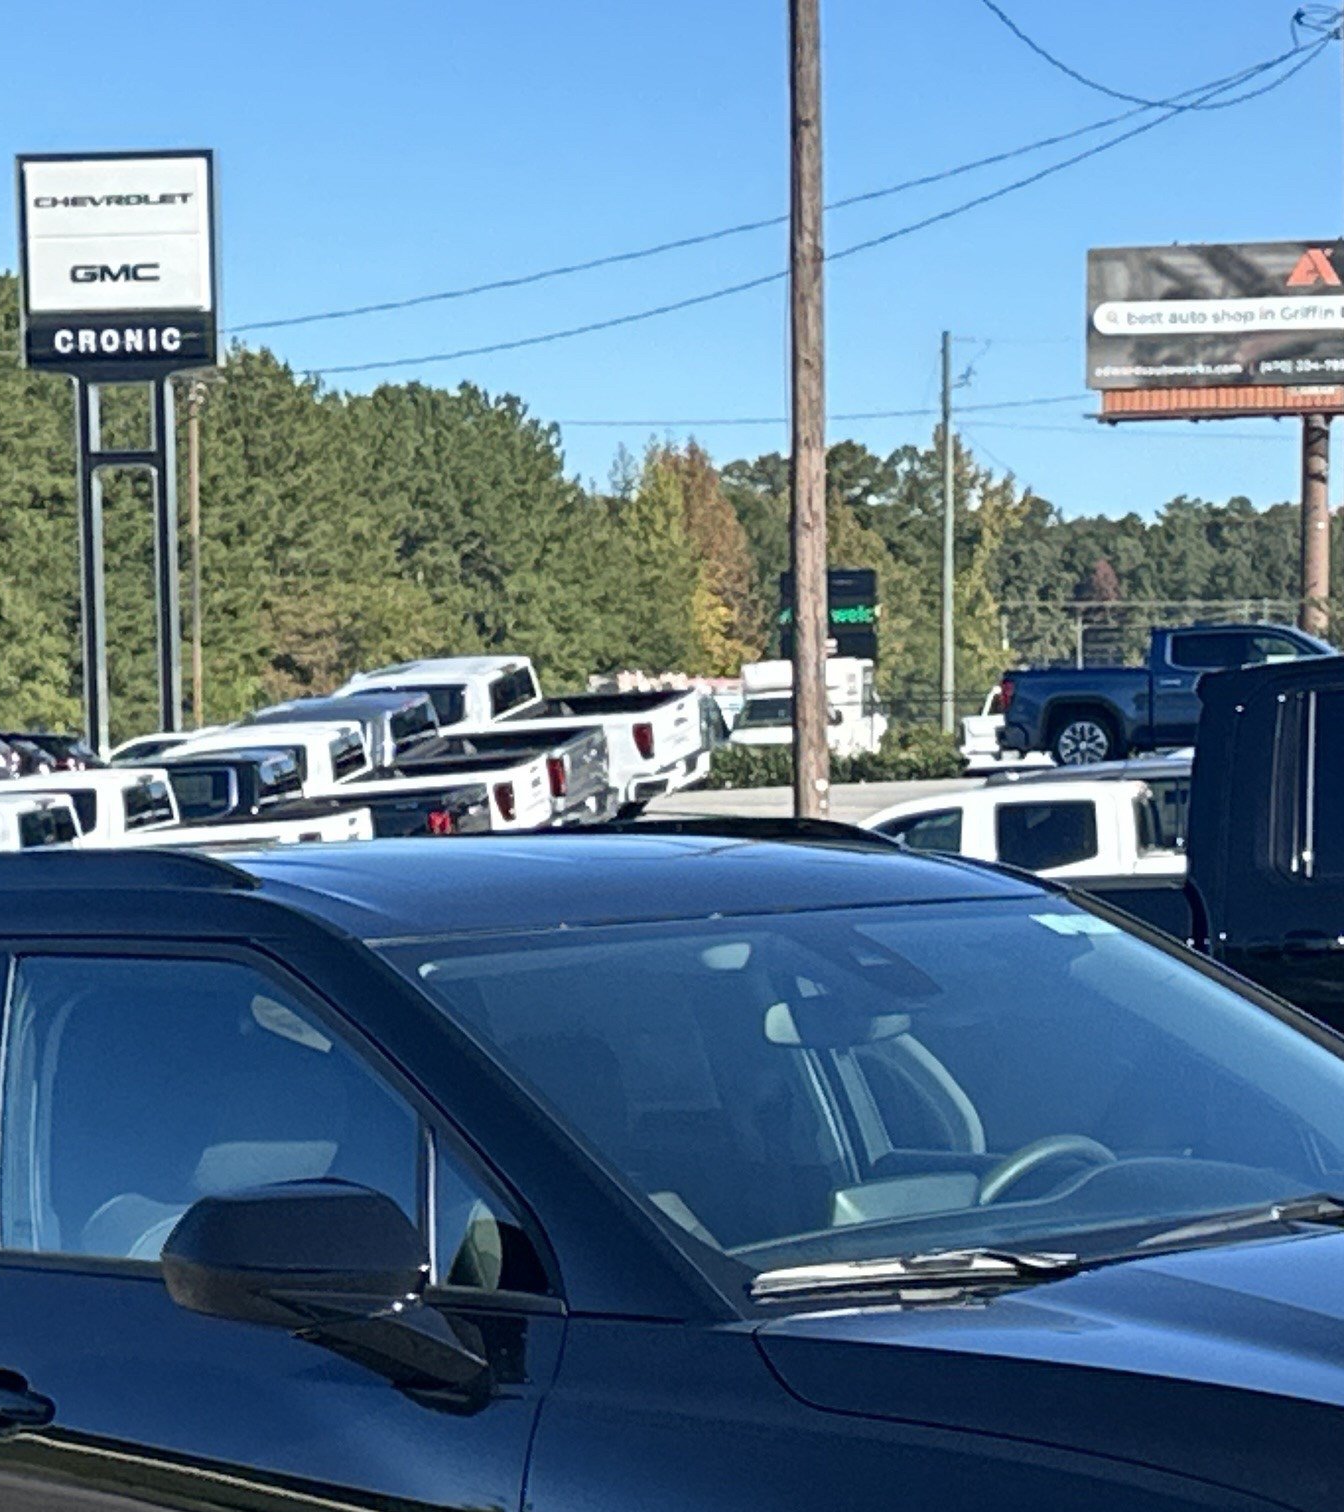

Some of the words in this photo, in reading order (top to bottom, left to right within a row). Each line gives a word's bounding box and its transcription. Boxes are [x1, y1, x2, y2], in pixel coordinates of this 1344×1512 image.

[33, 192, 193, 208] CHEVROLET
[70, 263, 160, 283] GMC
[1126, 309, 1163, 325] best
[1168, 308, 1207, 324] auto
[1212, 307, 1254, 326] shop
[1259, 305, 1275, 320] in
[1280, 304, 1335, 321] Griffin
[54, 327, 182, 353] CRONIC
